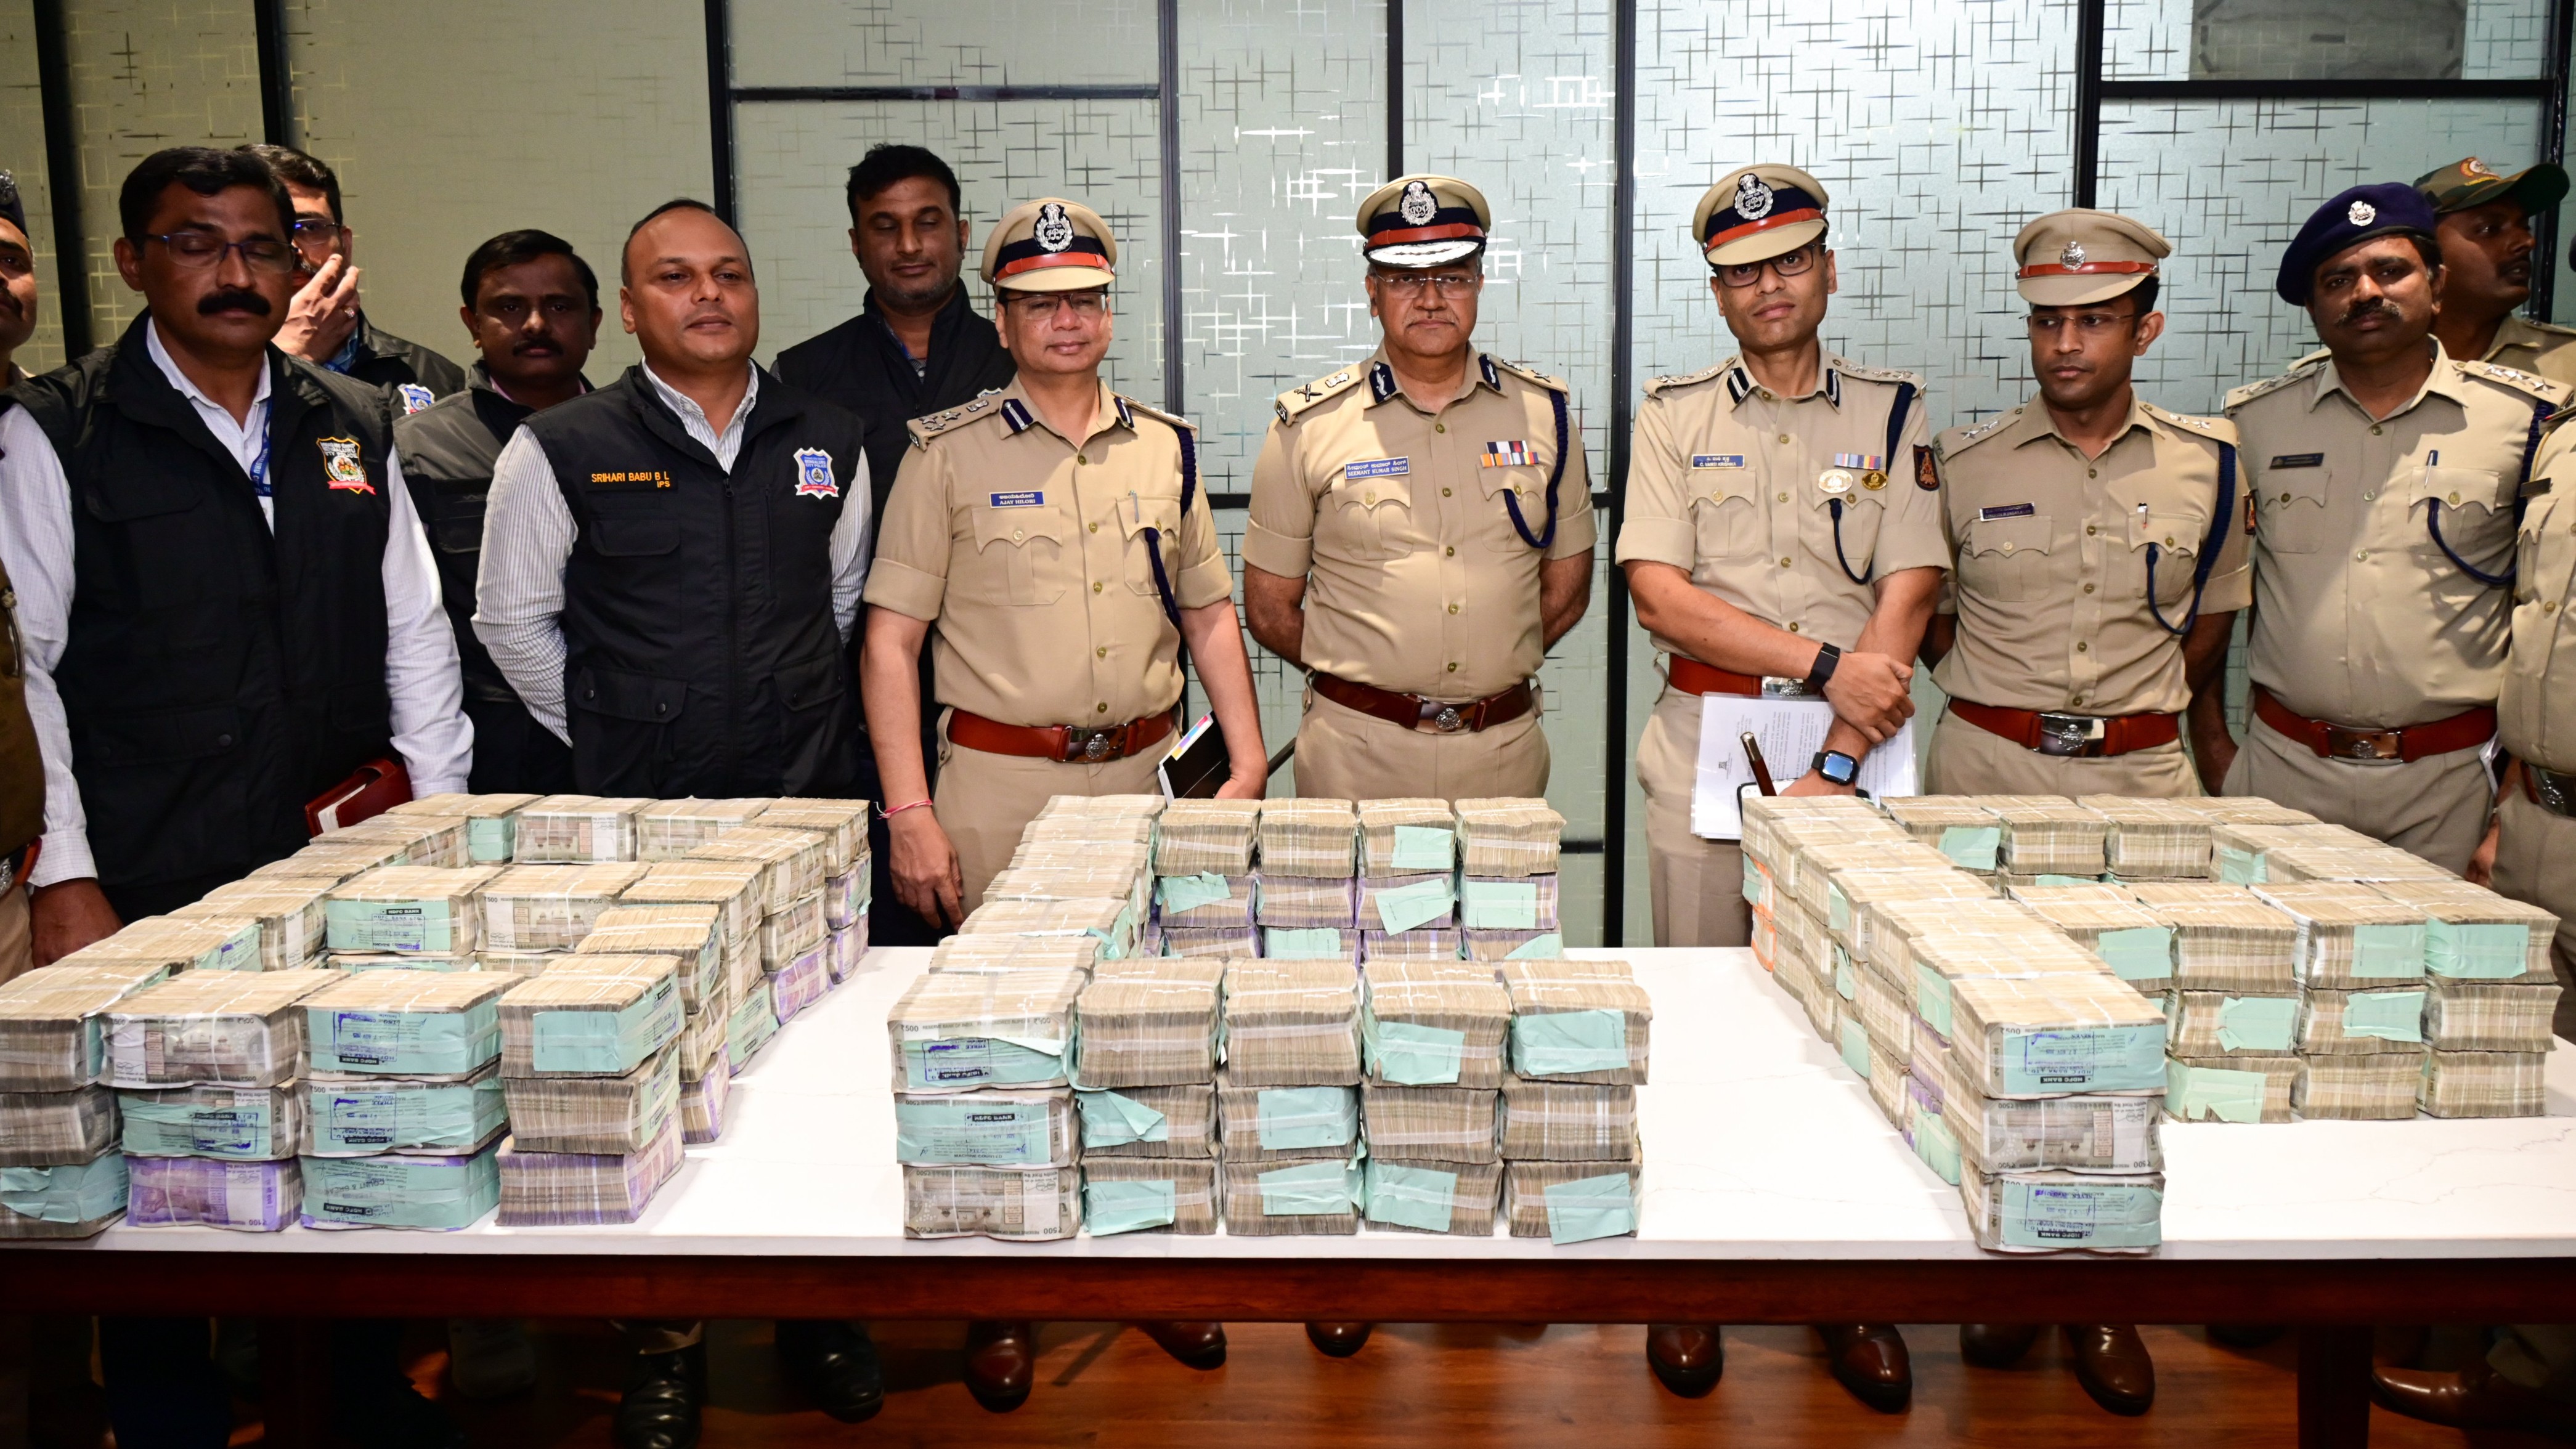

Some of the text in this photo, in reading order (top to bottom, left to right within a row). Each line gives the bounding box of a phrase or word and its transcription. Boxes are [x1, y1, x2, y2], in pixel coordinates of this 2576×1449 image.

[591, 471, 670, 482] SRIHARI BABU B L
[901, 1024, 919, 1032] ₹500
[2133, 1160, 2151, 1168] ₹500
[359, 1180, 385, 1189] COUNT
[1043, 1227, 1062, 1235] ₹500
